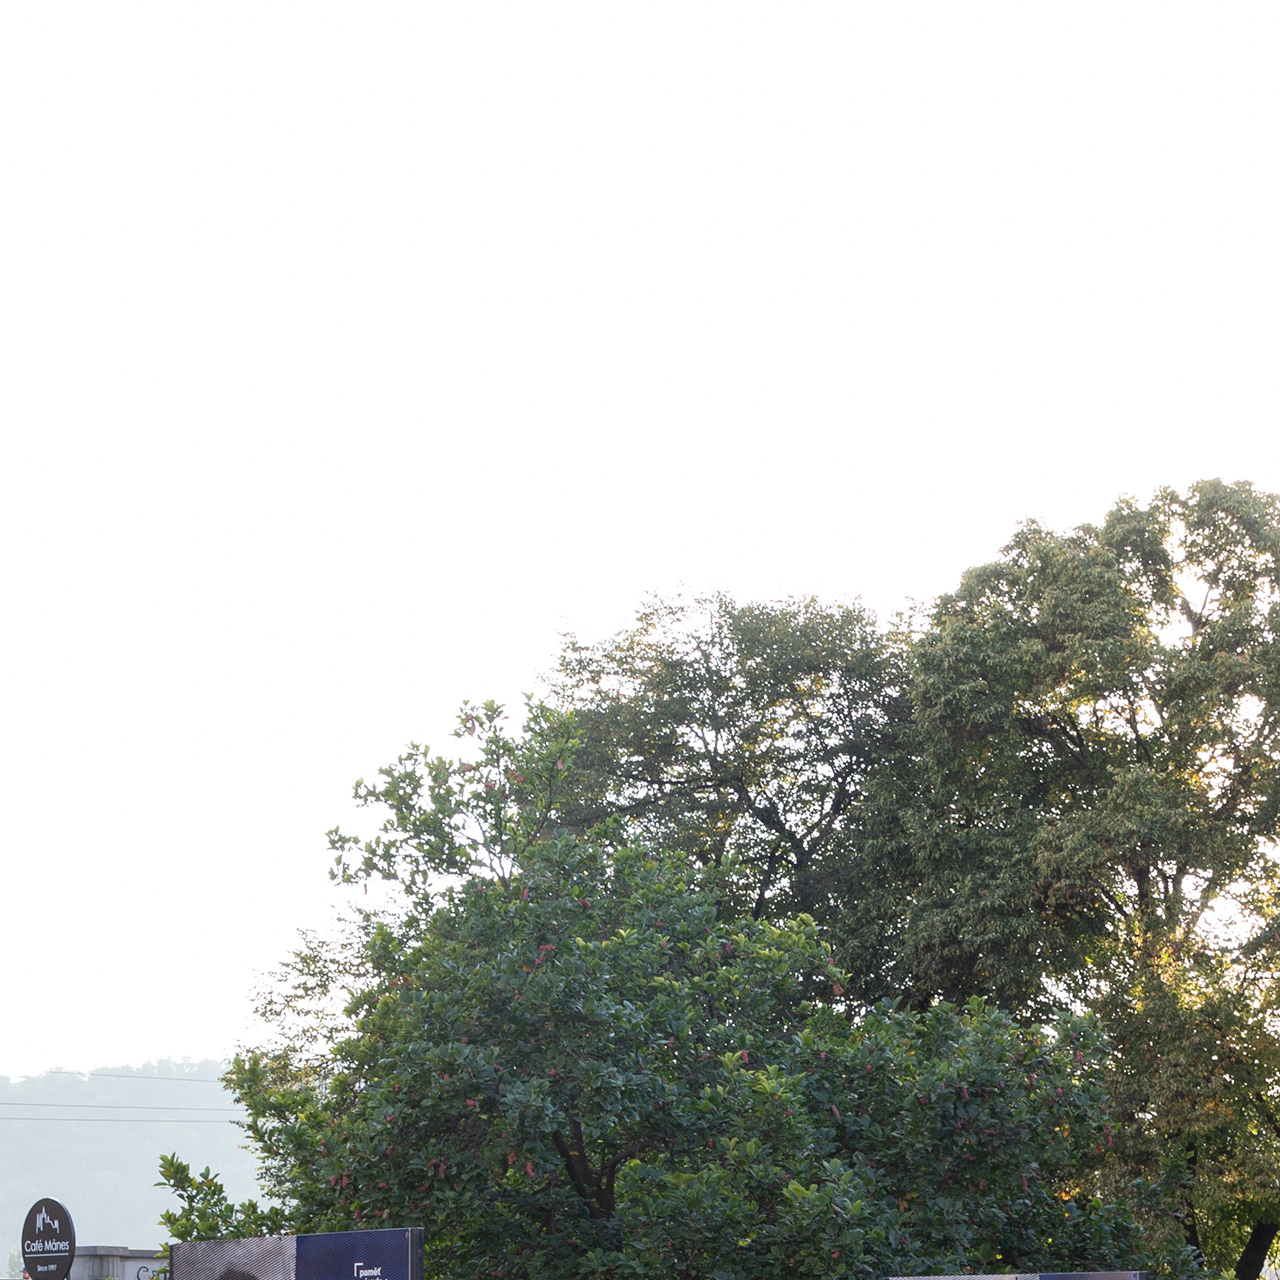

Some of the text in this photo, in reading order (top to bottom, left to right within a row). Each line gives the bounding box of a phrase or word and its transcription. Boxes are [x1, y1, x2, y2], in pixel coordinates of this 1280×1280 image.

[24, 1238, 70, 1252] Café Mánes
[360, 1267, 381, 1278] paměť
